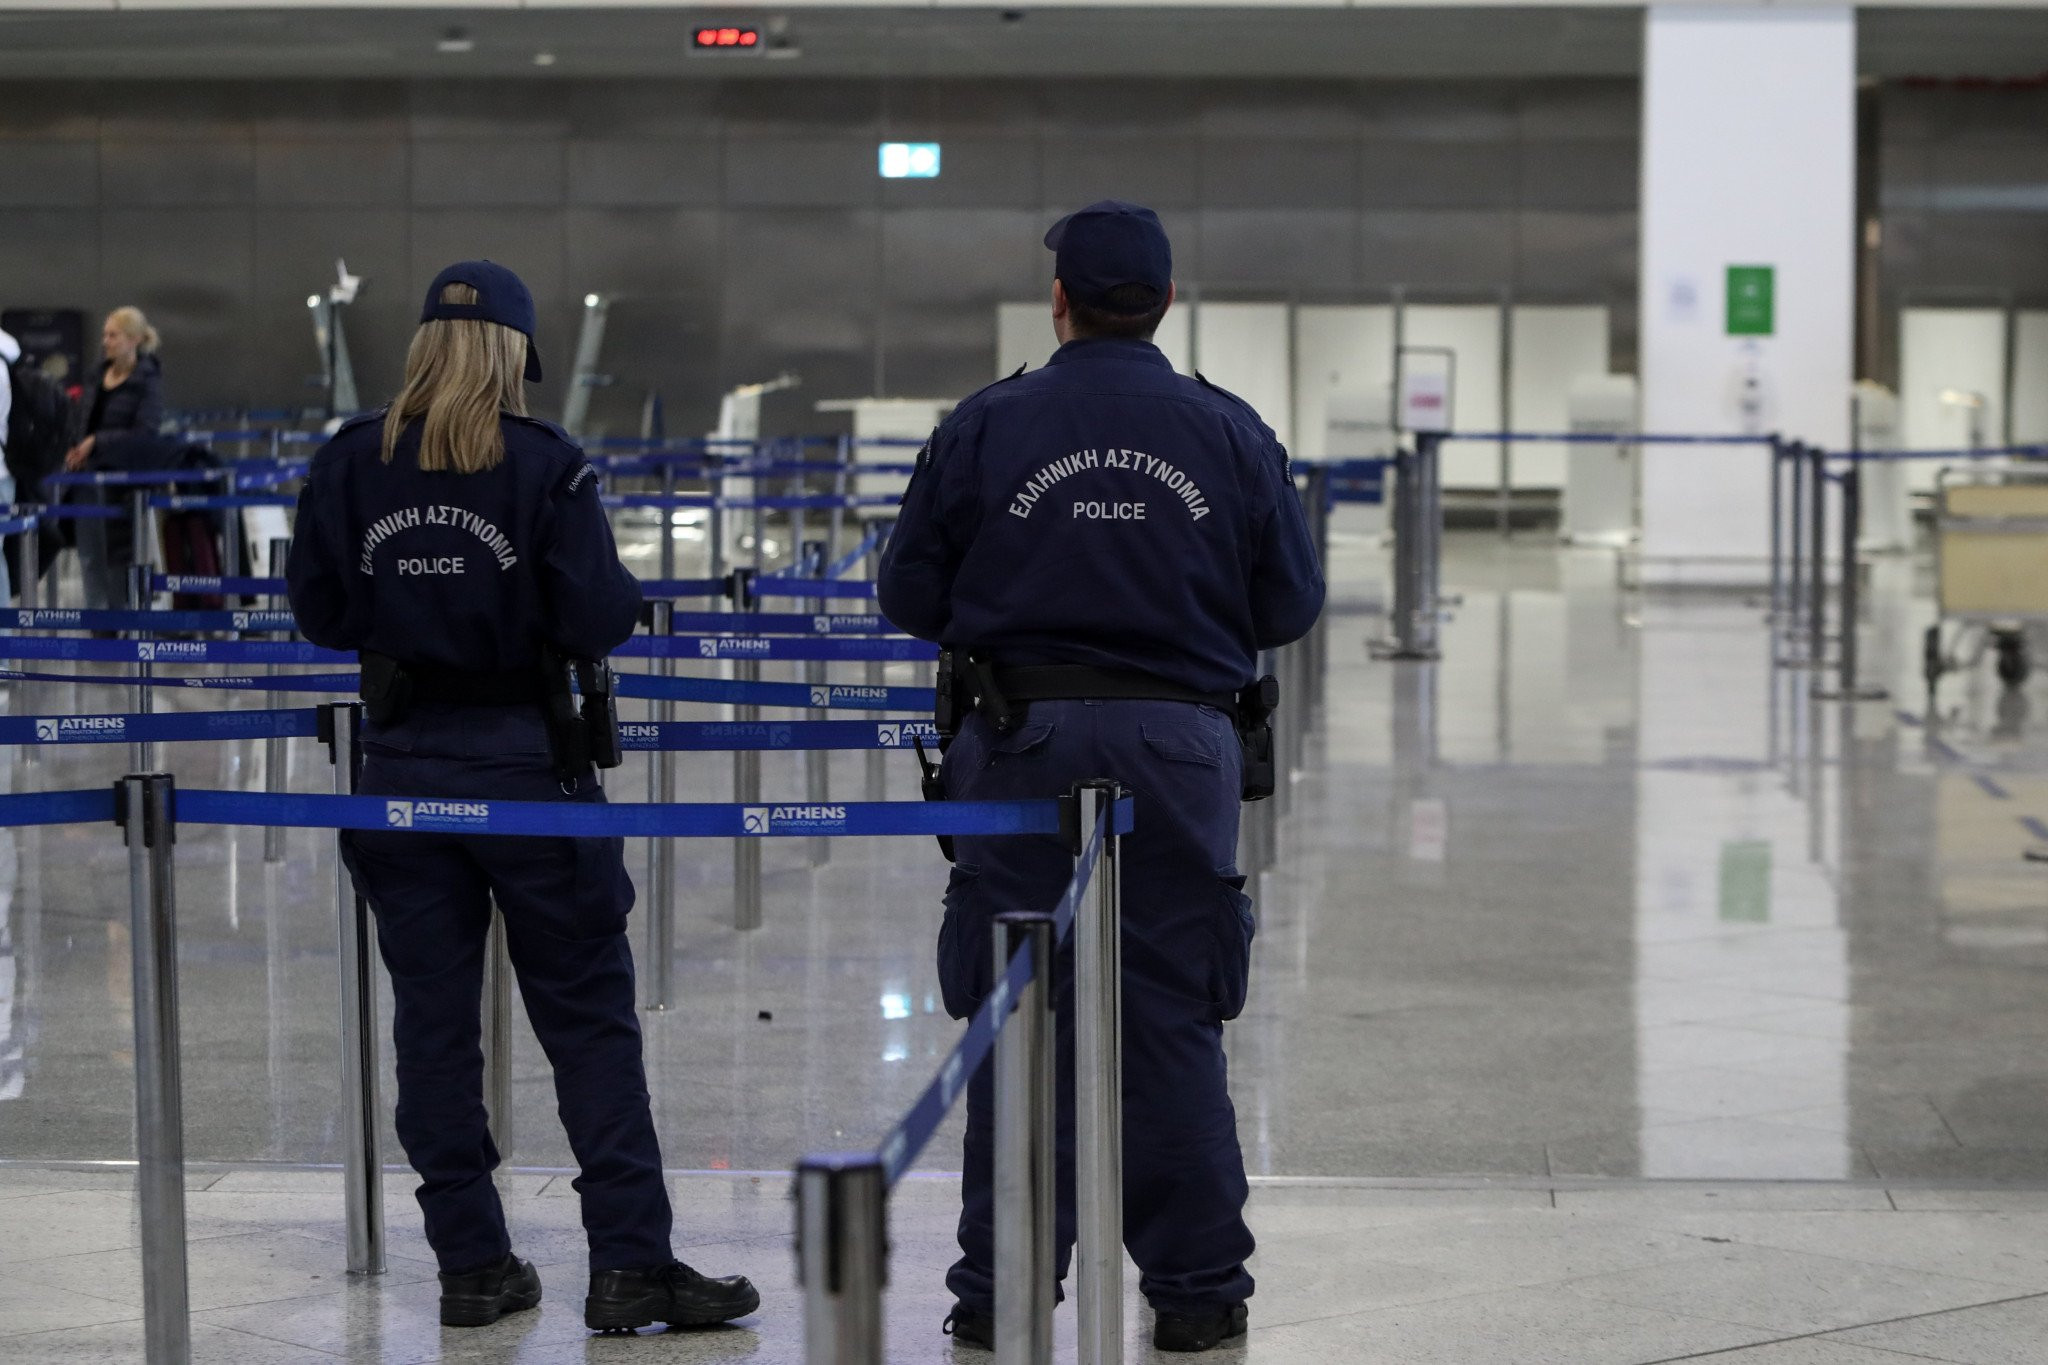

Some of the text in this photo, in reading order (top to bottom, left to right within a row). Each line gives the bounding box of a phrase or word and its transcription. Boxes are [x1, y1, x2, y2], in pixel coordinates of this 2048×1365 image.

[1009, 449, 1210, 521] ΕΛΛΗΝΙΚΗ ΑΣΤΥΝΟΜΙΑ
[1073, 502, 1146, 520] POLICE
[425, 505, 518, 571] ΑΣΤΥΝΟΜΙΑ
[397, 557, 465, 575] POLICE
[35, 610, 81, 620] ATHENS
[156, 642, 207, 652] ATHENS
[719, 639, 771, 649] ATHENS
[831, 686, 888, 699] ATHENS
[60, 717, 126, 730] ATHENS
[902, 723, 938, 735] ATH
[618, 725, 660, 737] HENS
[414, 802, 490, 817] ATHENS
[771, 806, 847, 820] ATHENS
